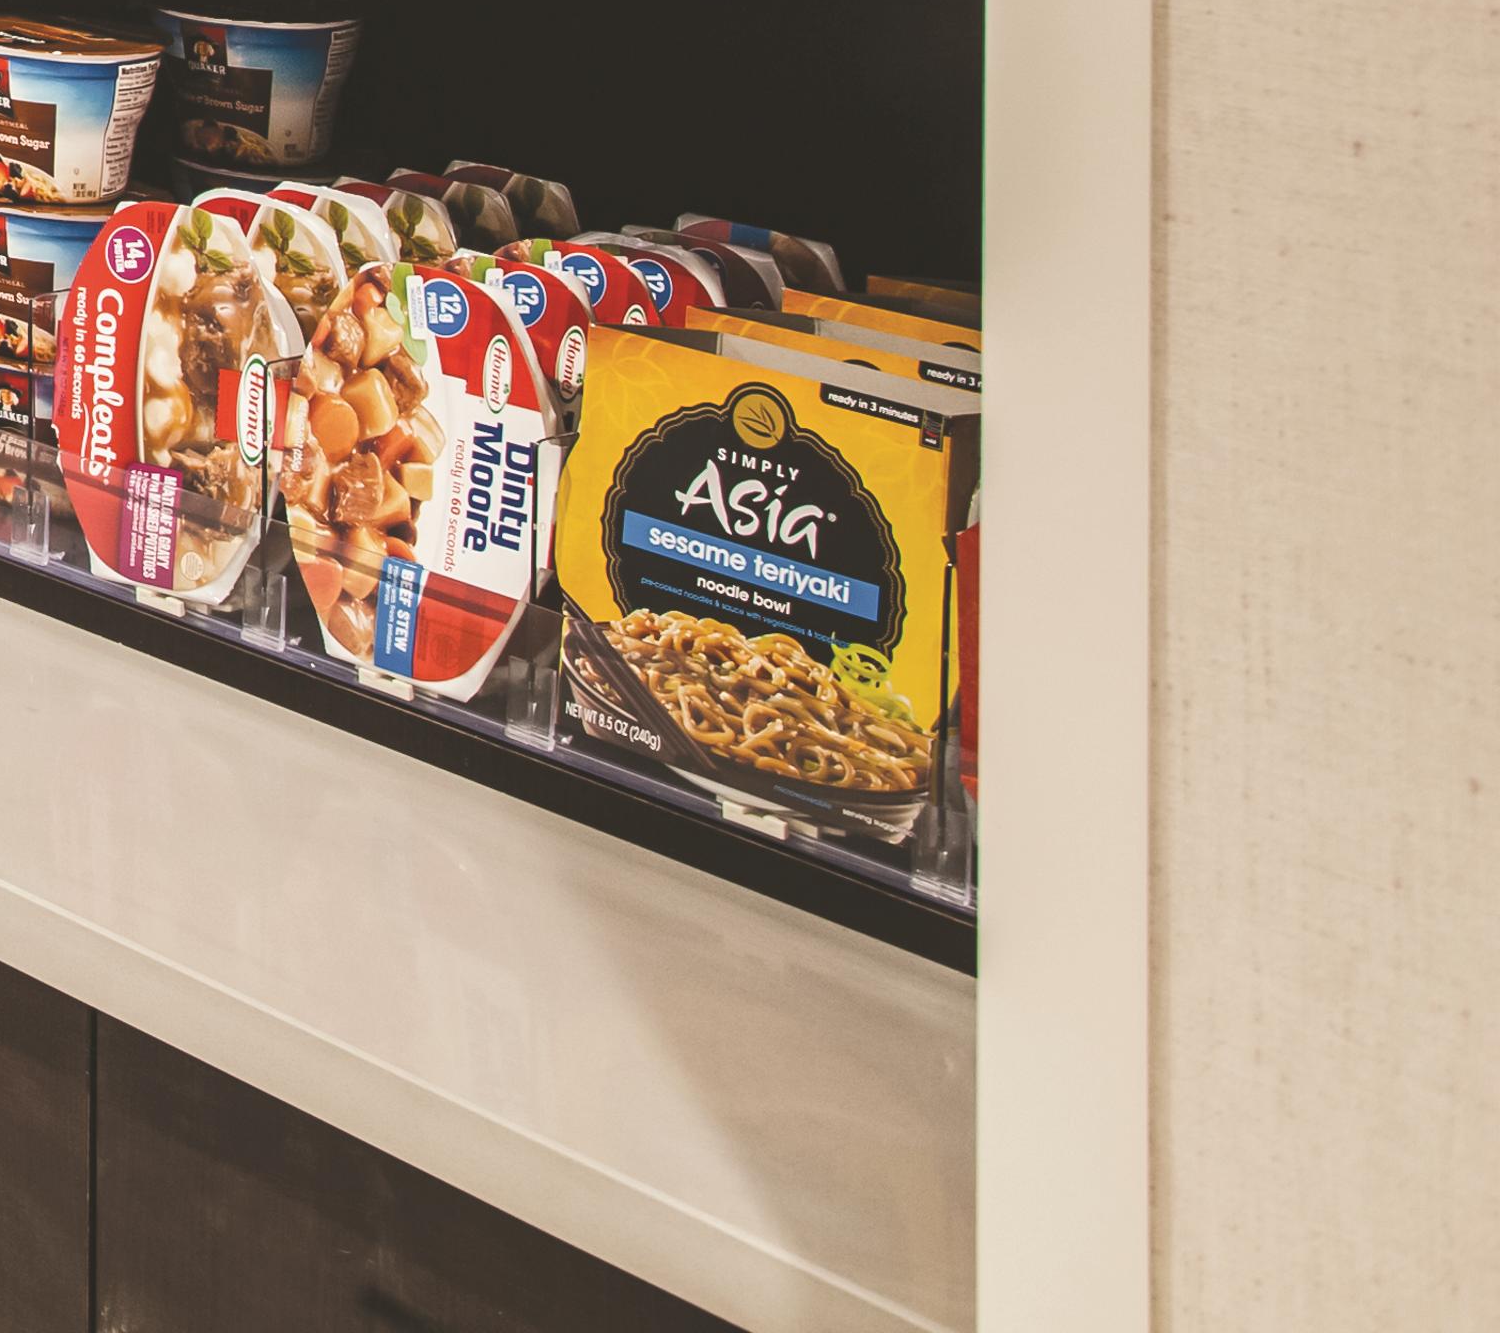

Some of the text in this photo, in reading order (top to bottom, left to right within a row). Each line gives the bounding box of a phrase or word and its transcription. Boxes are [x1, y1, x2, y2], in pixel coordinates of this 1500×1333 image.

[203, 96, 265, 114] Brown Sugar
[22, 136, 51, 151] Sugar
[125, 239, 143, 268] 14g
[438, 290, 463, 333] 12g
[88, 287, 124, 477] Compleats
[489, 337, 507, 409] Hormel
[559, 330, 583, 400] Hormel
[927, 367, 976, 386] ready in 3
[247, 359, 270, 455] Hormel
[463, 420, 504, 553] Moore
[489, 442, 535, 552] Dinty
[717, 447, 801, 481] SIMPLY
[675, 459, 827, 559] Asia
[649, 525, 850, 605] sesame teriyaki
[696, 574, 792, 616] noodle bowl
[395, 568, 416, 653] BEEF STEW
